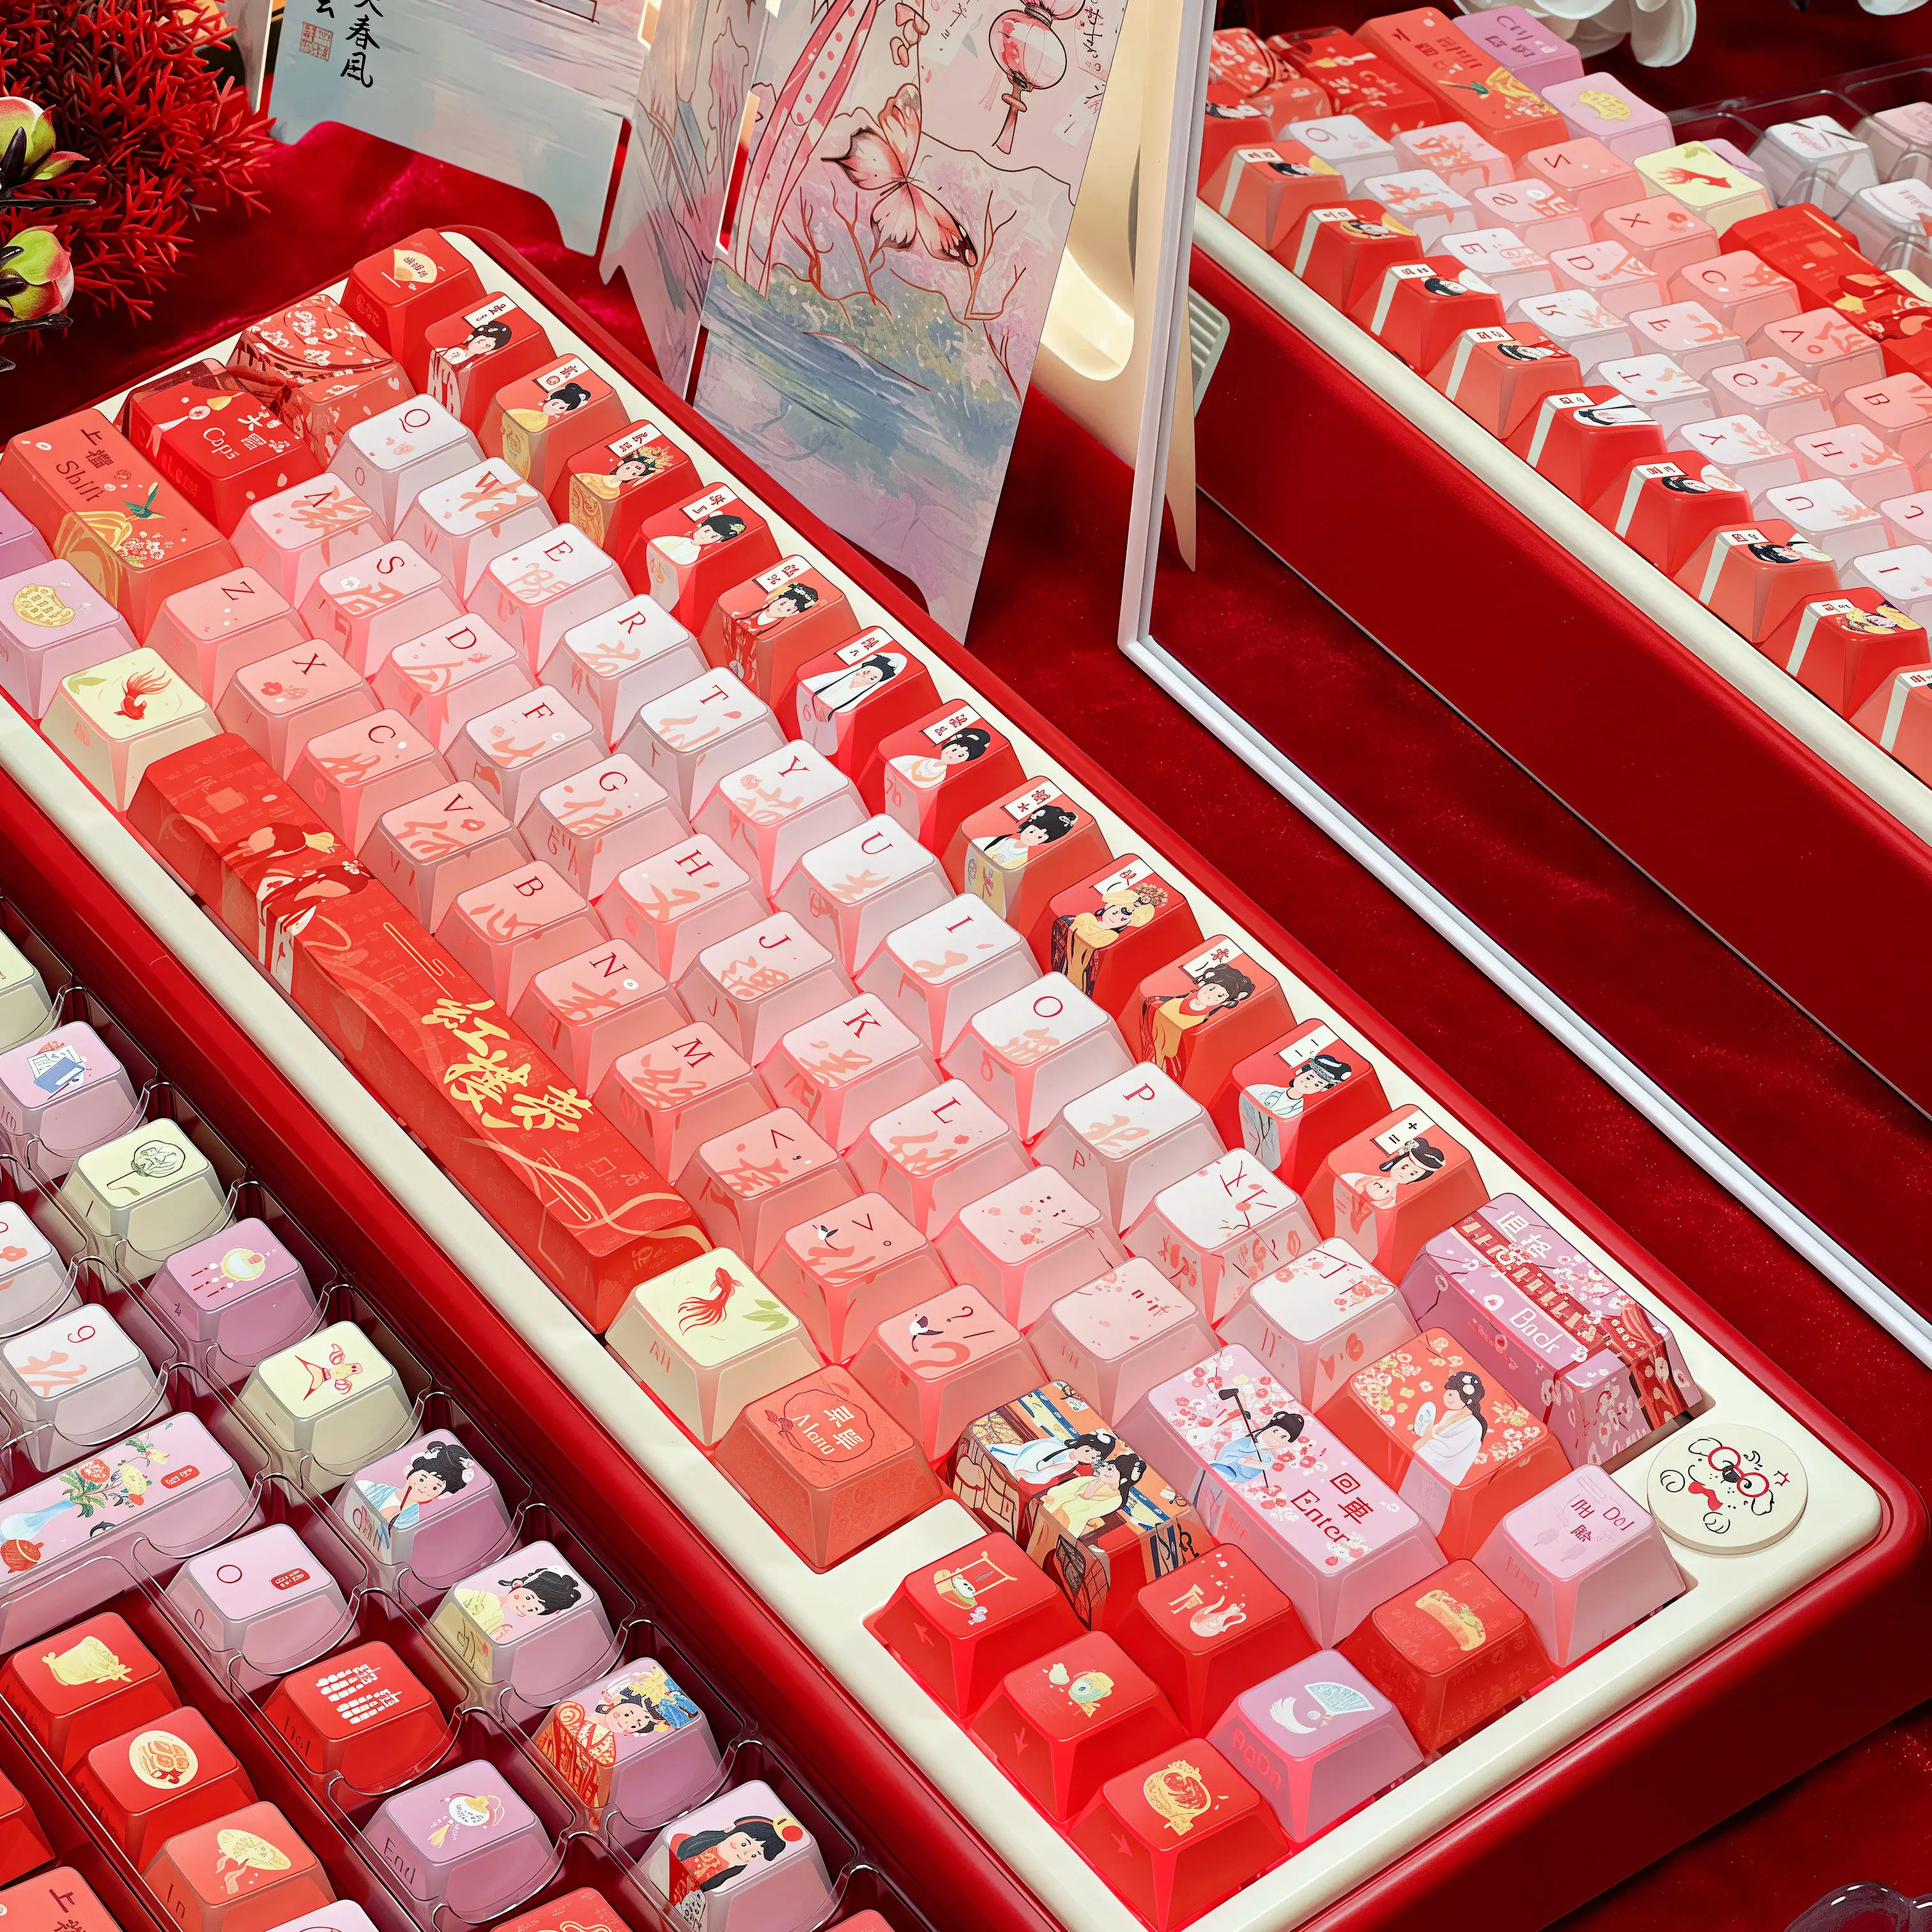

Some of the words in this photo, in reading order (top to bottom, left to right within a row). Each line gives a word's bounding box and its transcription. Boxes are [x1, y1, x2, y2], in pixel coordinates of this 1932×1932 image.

[399, 408, 430, 433] Q
[203, 428, 240, 459] Caps
[544, 540, 574, 562] E
[376, 556, 405, 574] S
[220, 581, 255, 600] Z
[617, 610, 646, 634] R
[445, 627, 476, 649] D
[292, 653, 327, 675] X
[700, 684, 729, 705] T
[522, 702, 555, 720] F
[368, 724, 396, 743] C
[777, 755, 811, 778] Y
[599, 771, 627, 792] G
[443, 793, 474, 811] V
[861, 831, 893, 855] U
[674, 849, 714, 877] H
[512, 875, 544, 896] B
[946, 915, 974, 933] I
[759, 934, 792, 949] J
[589, 951, 629, 978] N
[843, 1009, 882, 1039] K
[671, 1038, 714, 1069] M
[1122, 1083, 1155, 1103] P
[931, 1096, 961, 1124] L
[1509, 1307, 1563, 1354] Back
[1330, 1473, 1374, 1524] 回車
[1290, 1489, 1351, 1544] Enter
